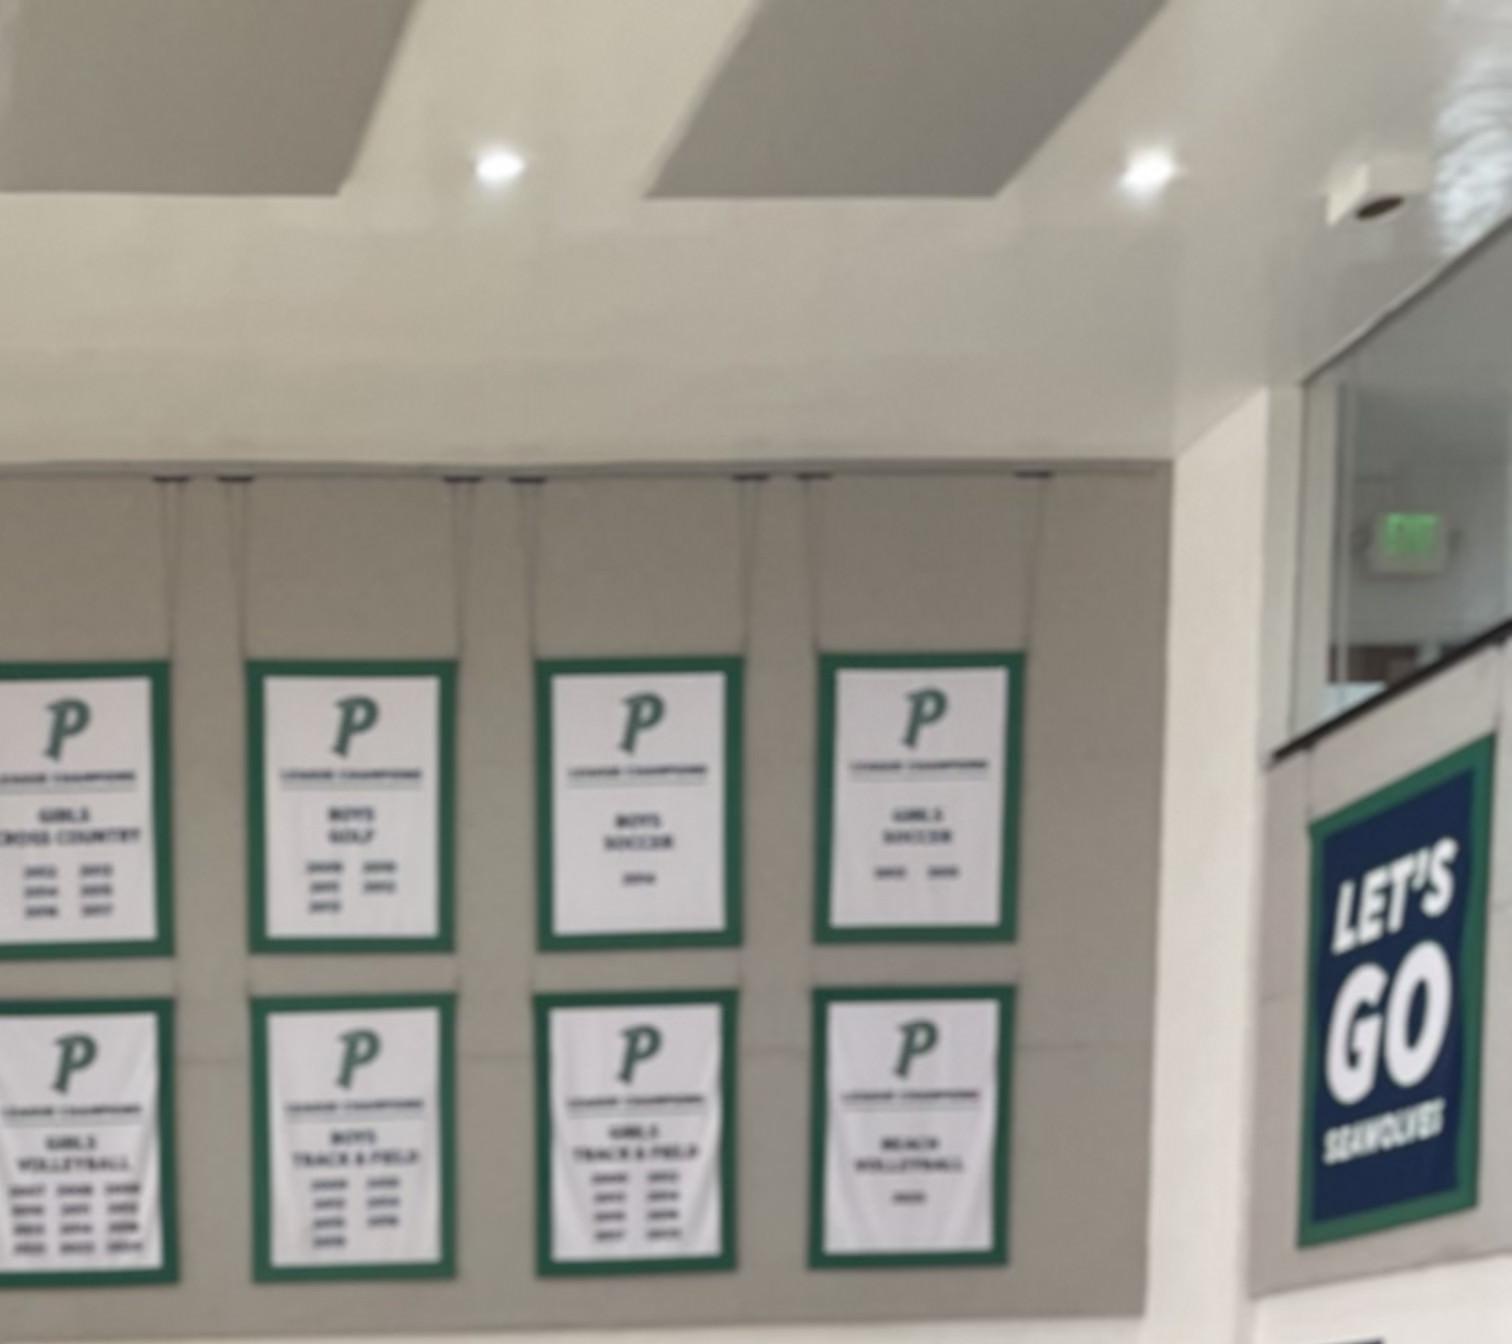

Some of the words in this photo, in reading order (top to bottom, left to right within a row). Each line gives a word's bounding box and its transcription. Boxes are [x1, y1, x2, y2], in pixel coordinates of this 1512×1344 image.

[44, 697, 92, 762] P
[332, 695, 379, 759] P
[619, 691, 666, 755] P
[901, 686, 949, 748] P
[1331, 837, 1459, 955] LET'S
[617, 1023, 663, 1084] P
[894, 1018, 939, 1079] P
[1326, 940, 1453, 1105] GO
[51, 1033, 99, 1095] P
[336, 1029, 381, 1089] P
[1323, 1098, 1446, 1165] SEAWOLVES
